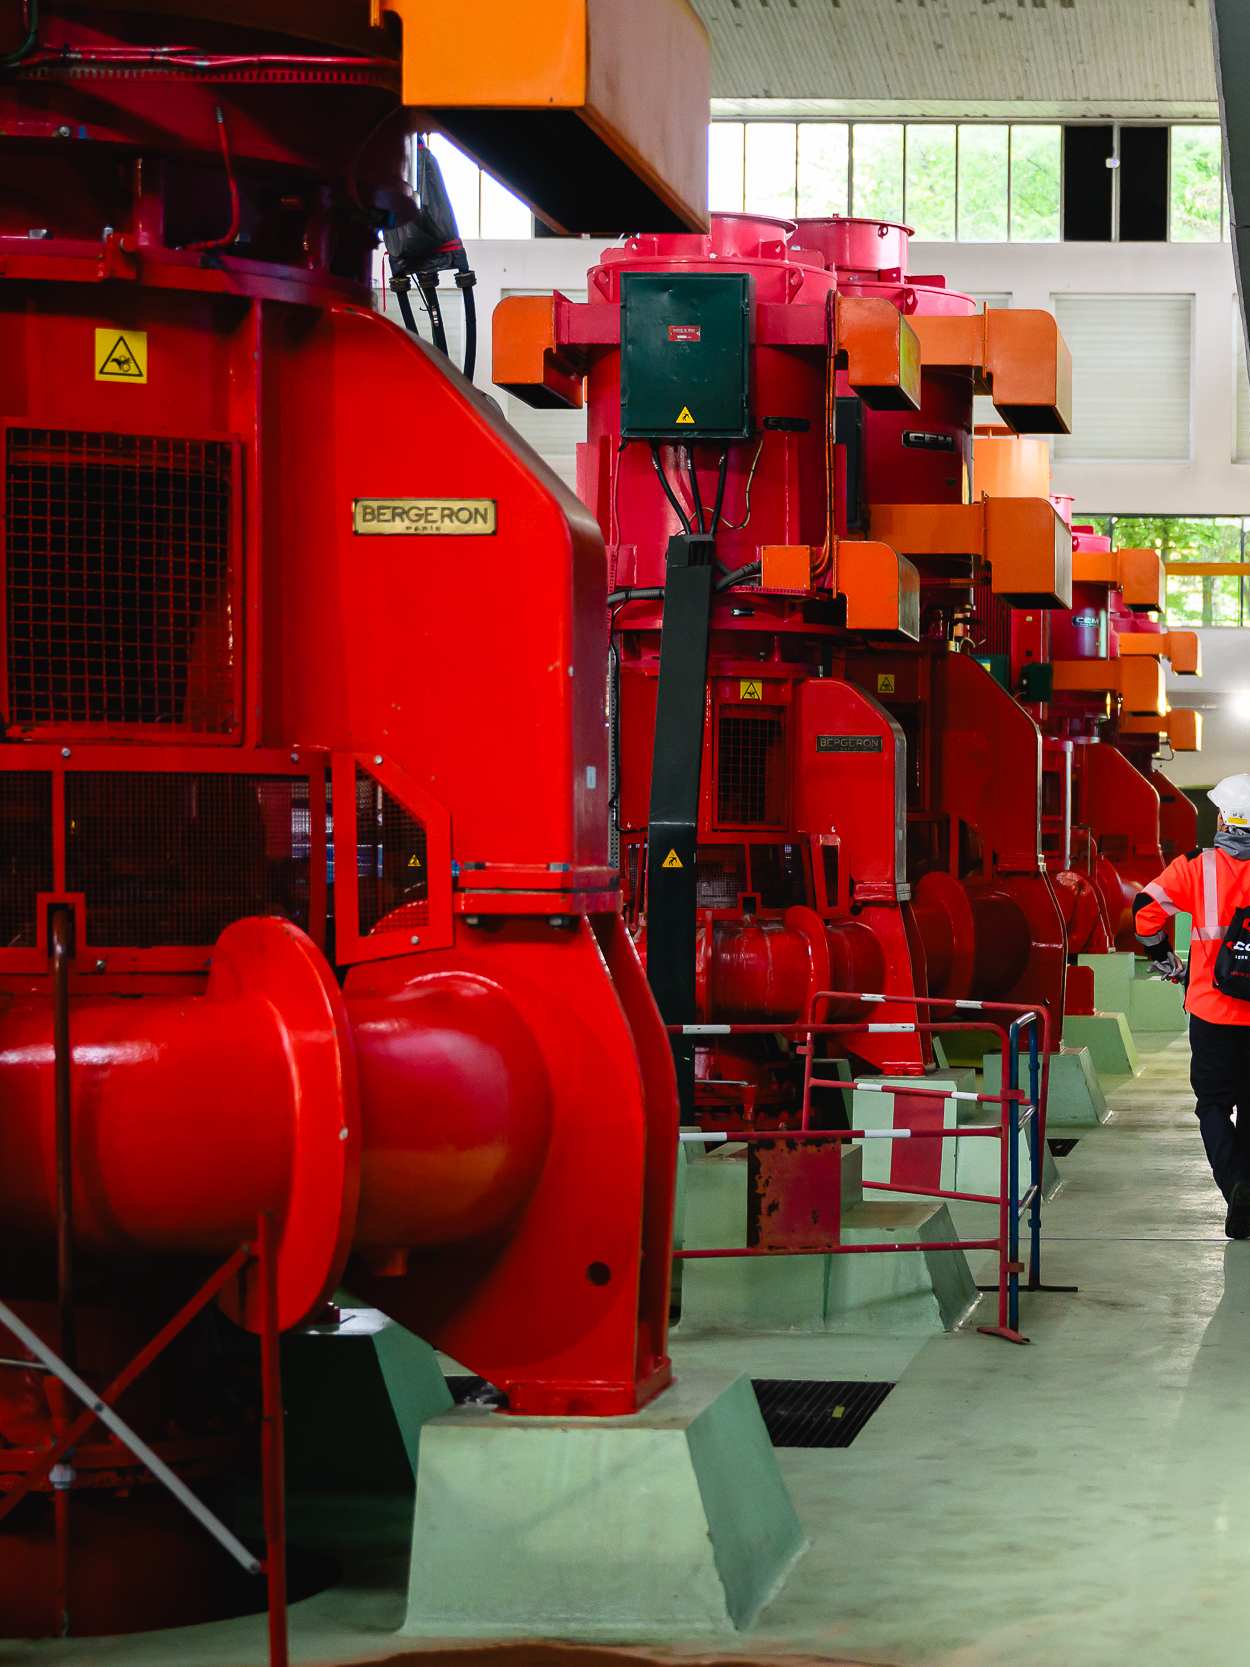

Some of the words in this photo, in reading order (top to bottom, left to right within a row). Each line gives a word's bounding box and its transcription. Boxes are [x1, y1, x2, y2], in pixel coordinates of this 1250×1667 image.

[909, 432, 952, 445] CEM
[362, 505, 488, 524] BERGERON
[820, 738, 879, 748] BERGERON
